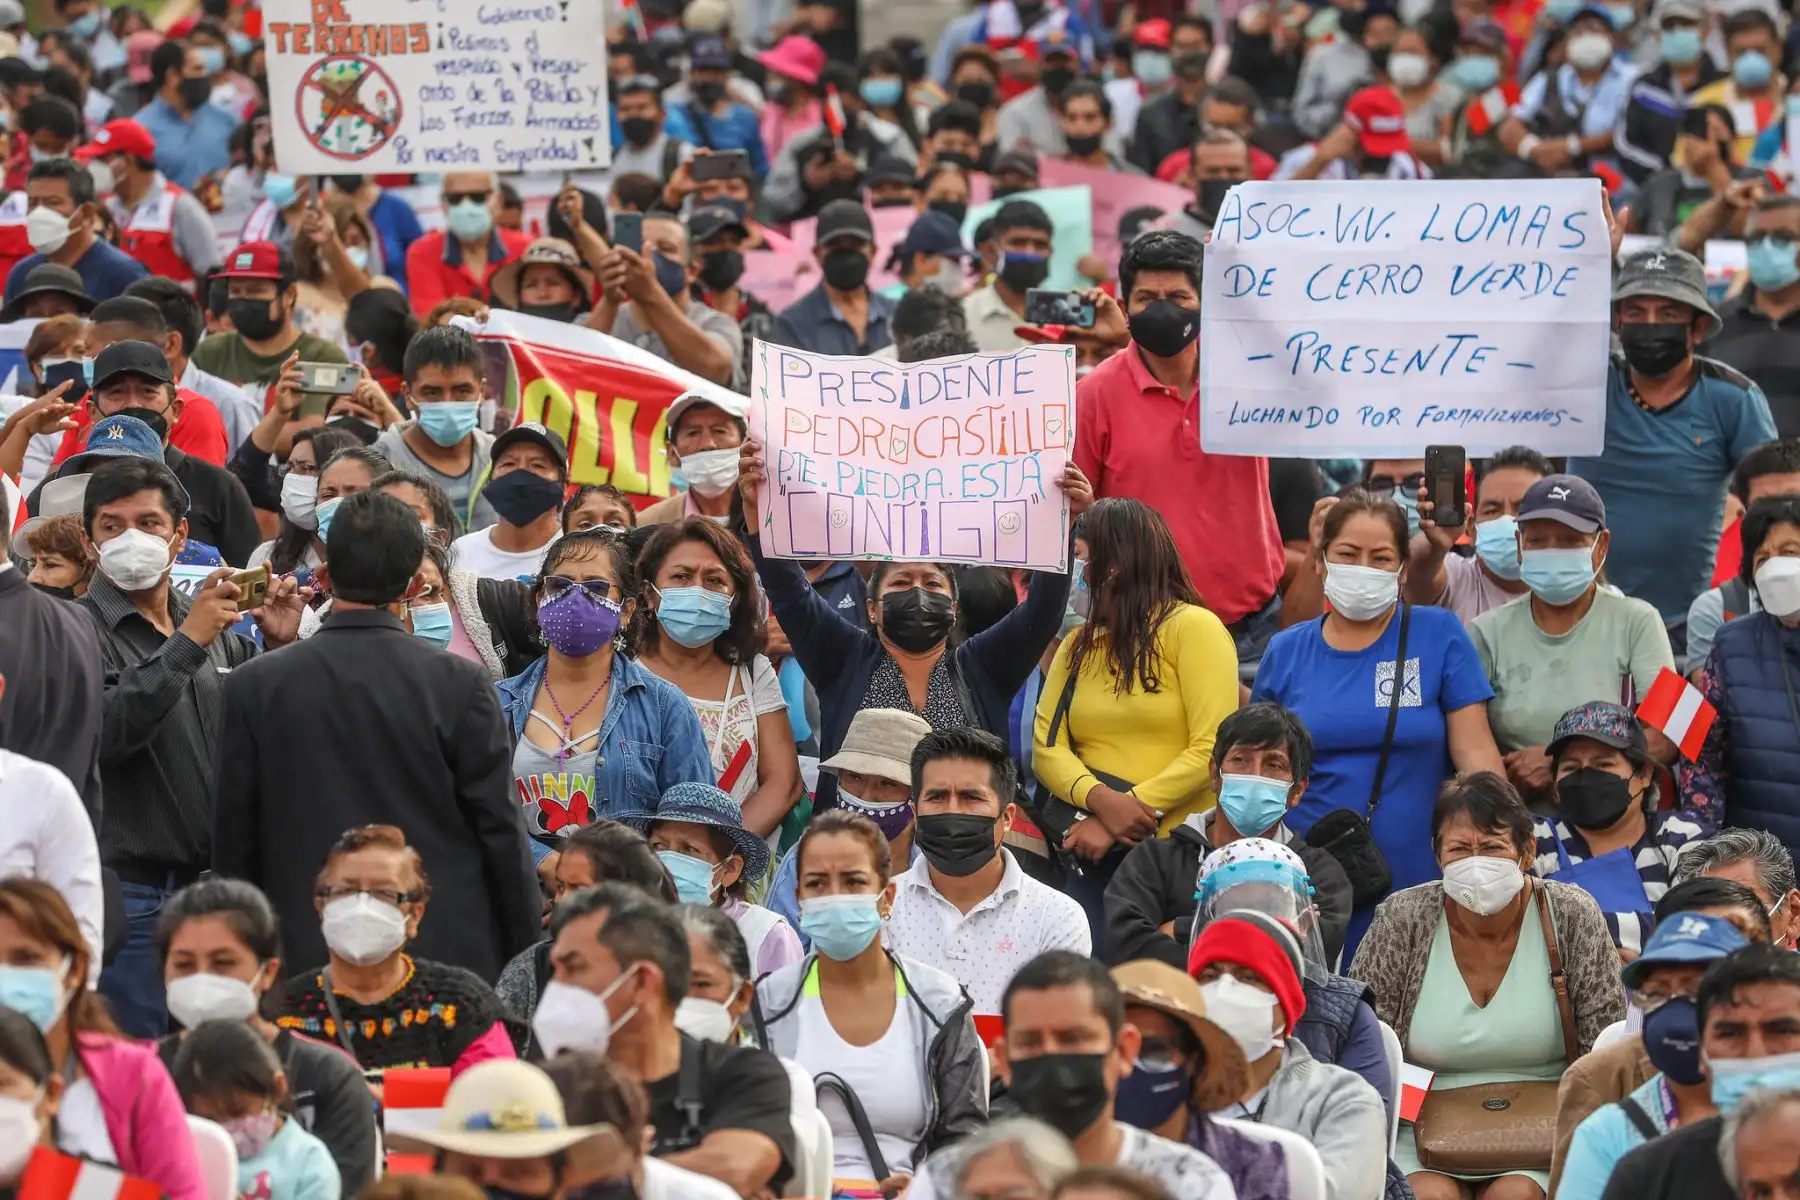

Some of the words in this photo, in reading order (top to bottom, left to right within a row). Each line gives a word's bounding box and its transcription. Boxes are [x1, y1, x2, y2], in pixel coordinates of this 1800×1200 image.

[312, 0, 352, 23] DE
[268, 22, 430, 57] TERRENOS
[1420, 202, 1588, 249] LOMAS
[1221, 263, 1277, 298] DE
[1306, 263, 1424, 301] CERRO
[1450, 261, 1580, 300] VERDE
[1228, 400, 1339, 429] LUCHANDO
[1356, 405, 1400, 428] POR
[521, 377, 670, 498] OLL
[783, 406, 910, 464] PEDRO
[962, 450, 1046, 499] ESTÁ
[1379, 676, 1418, 697] OK
